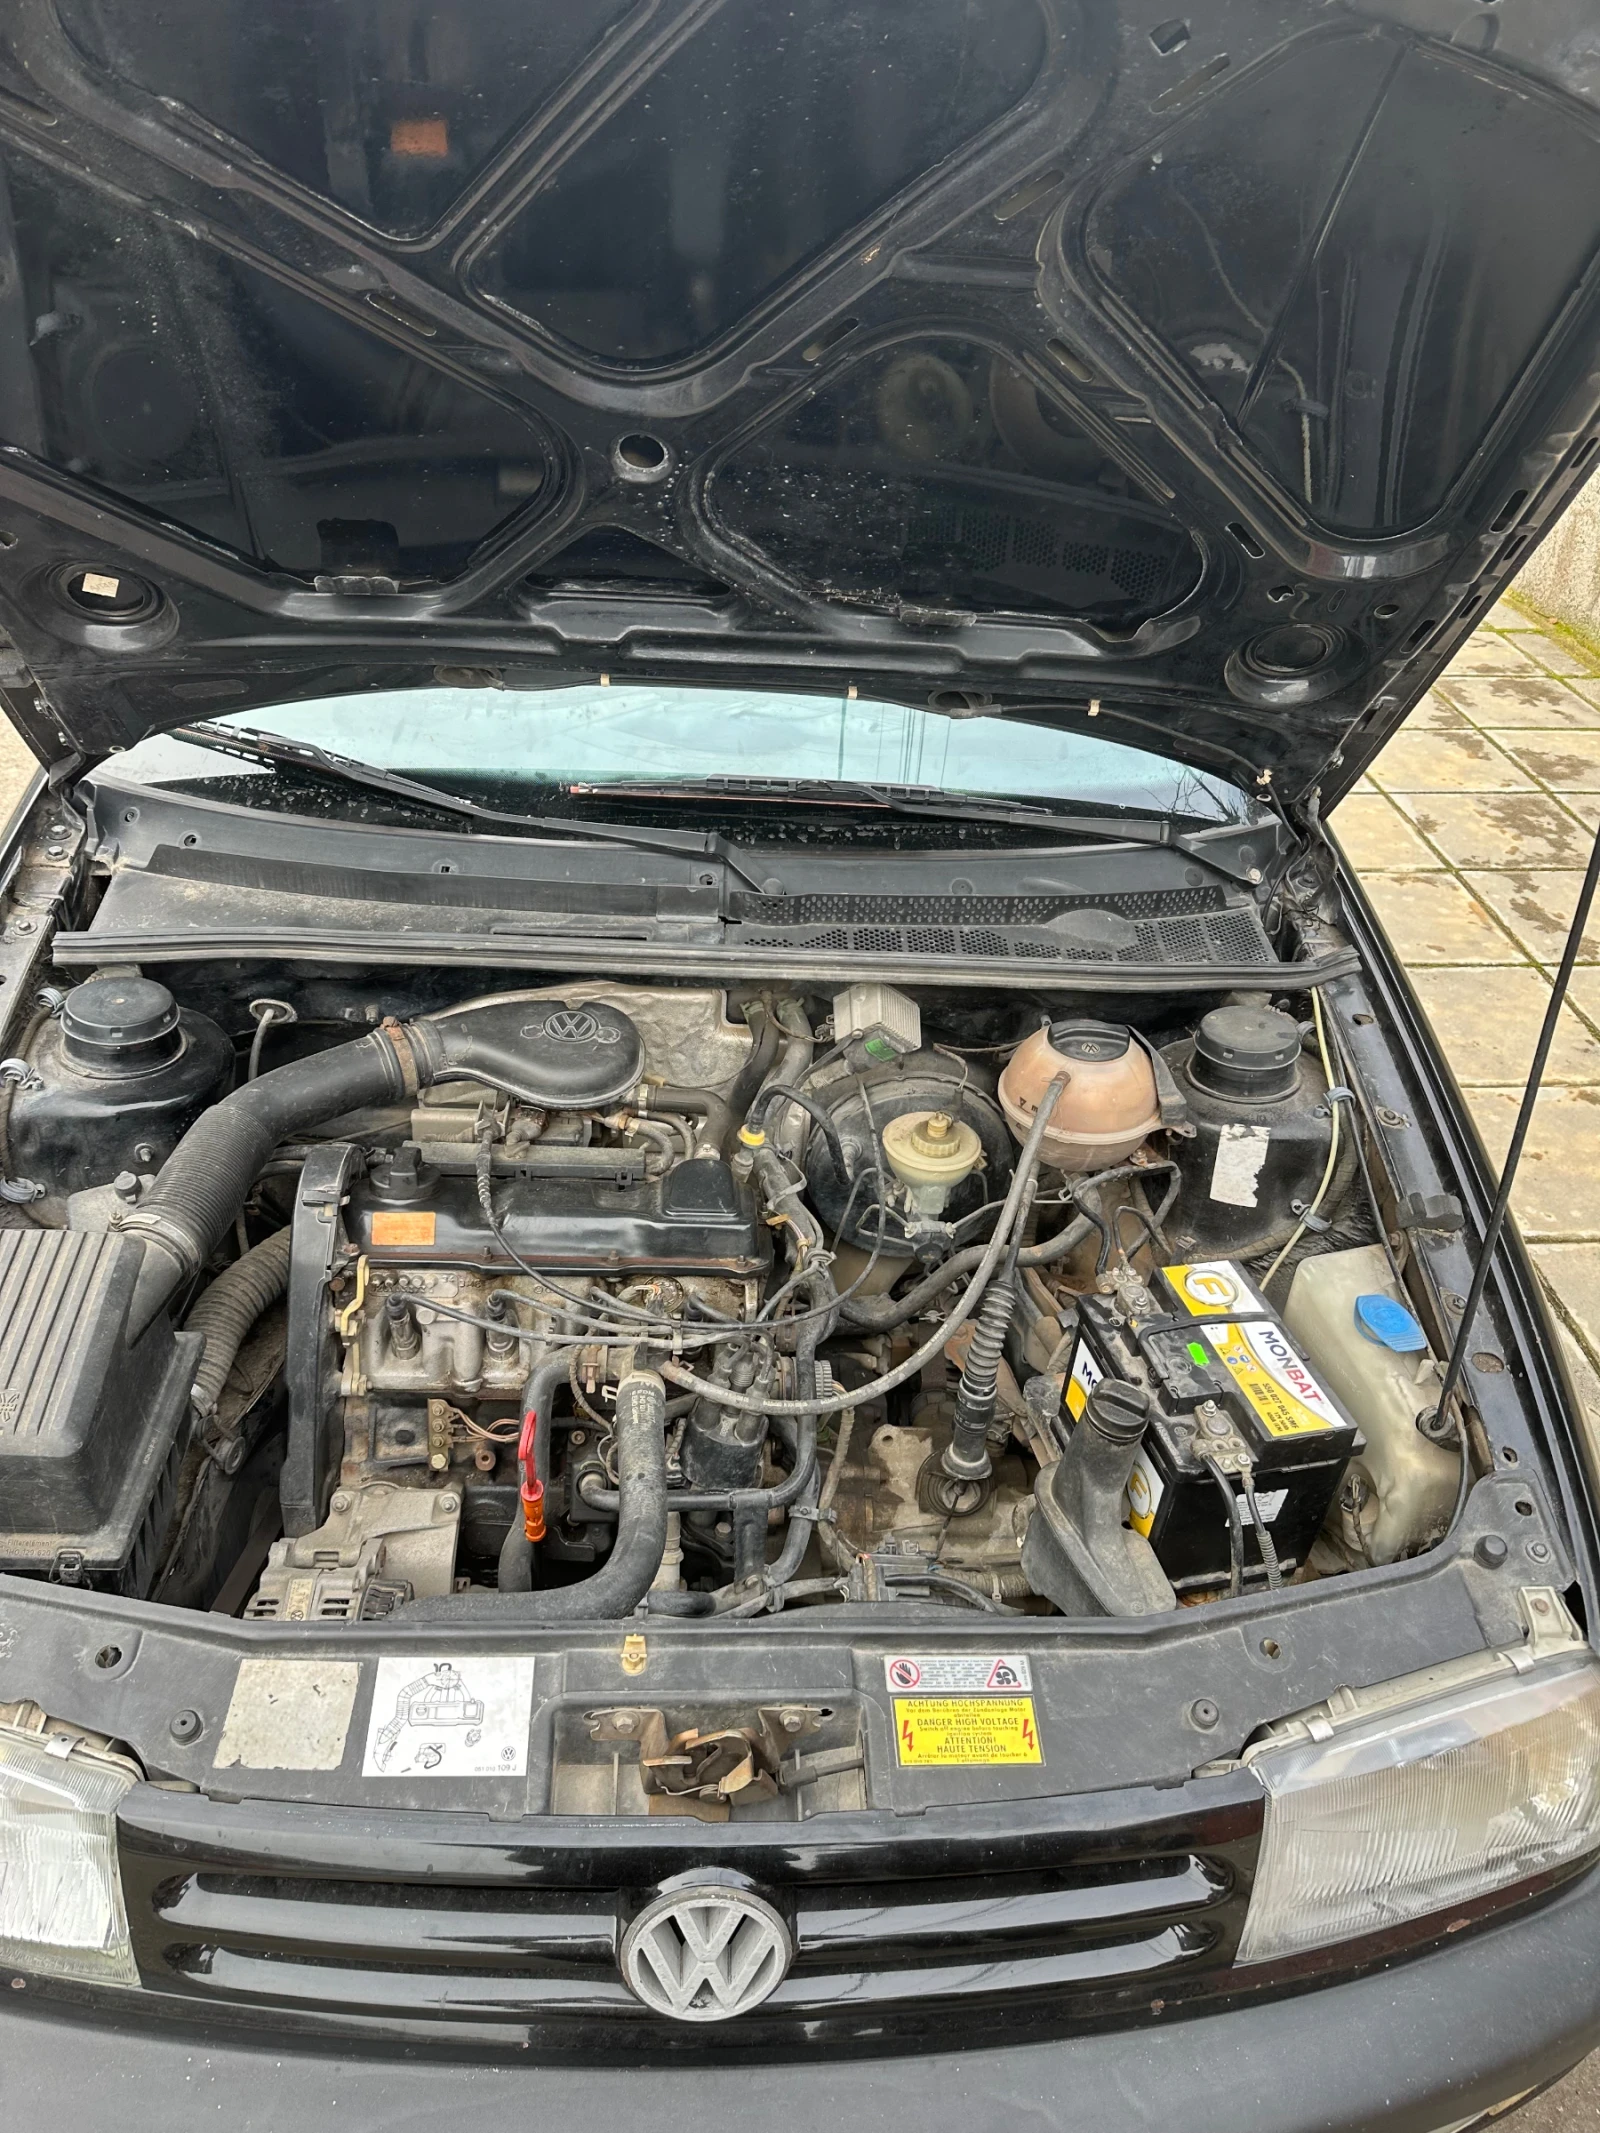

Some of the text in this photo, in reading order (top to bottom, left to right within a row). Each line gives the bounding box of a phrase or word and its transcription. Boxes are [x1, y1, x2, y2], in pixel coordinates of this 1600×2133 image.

[546, 1010, 597, 1041] VW
[1193, 1277, 1231, 1297] F
[1258, 1330, 1322, 1402] MONBAT
[1286, 1416, 1299, 1429] SMF
[952, 1699, 1023, 1707] HOCHSPANNUNG
[917, 1718, 953, 1726] DANGER
[980, 1717, 1019, 1725] VOLTAGE
[945, 1737, 996, 1745] ATTENTION!
[501, 1746, 516, 1761] VW
[937, 1744, 1007, 1753] HAUTE TENSION
[628, 1899, 786, 2021] VW
